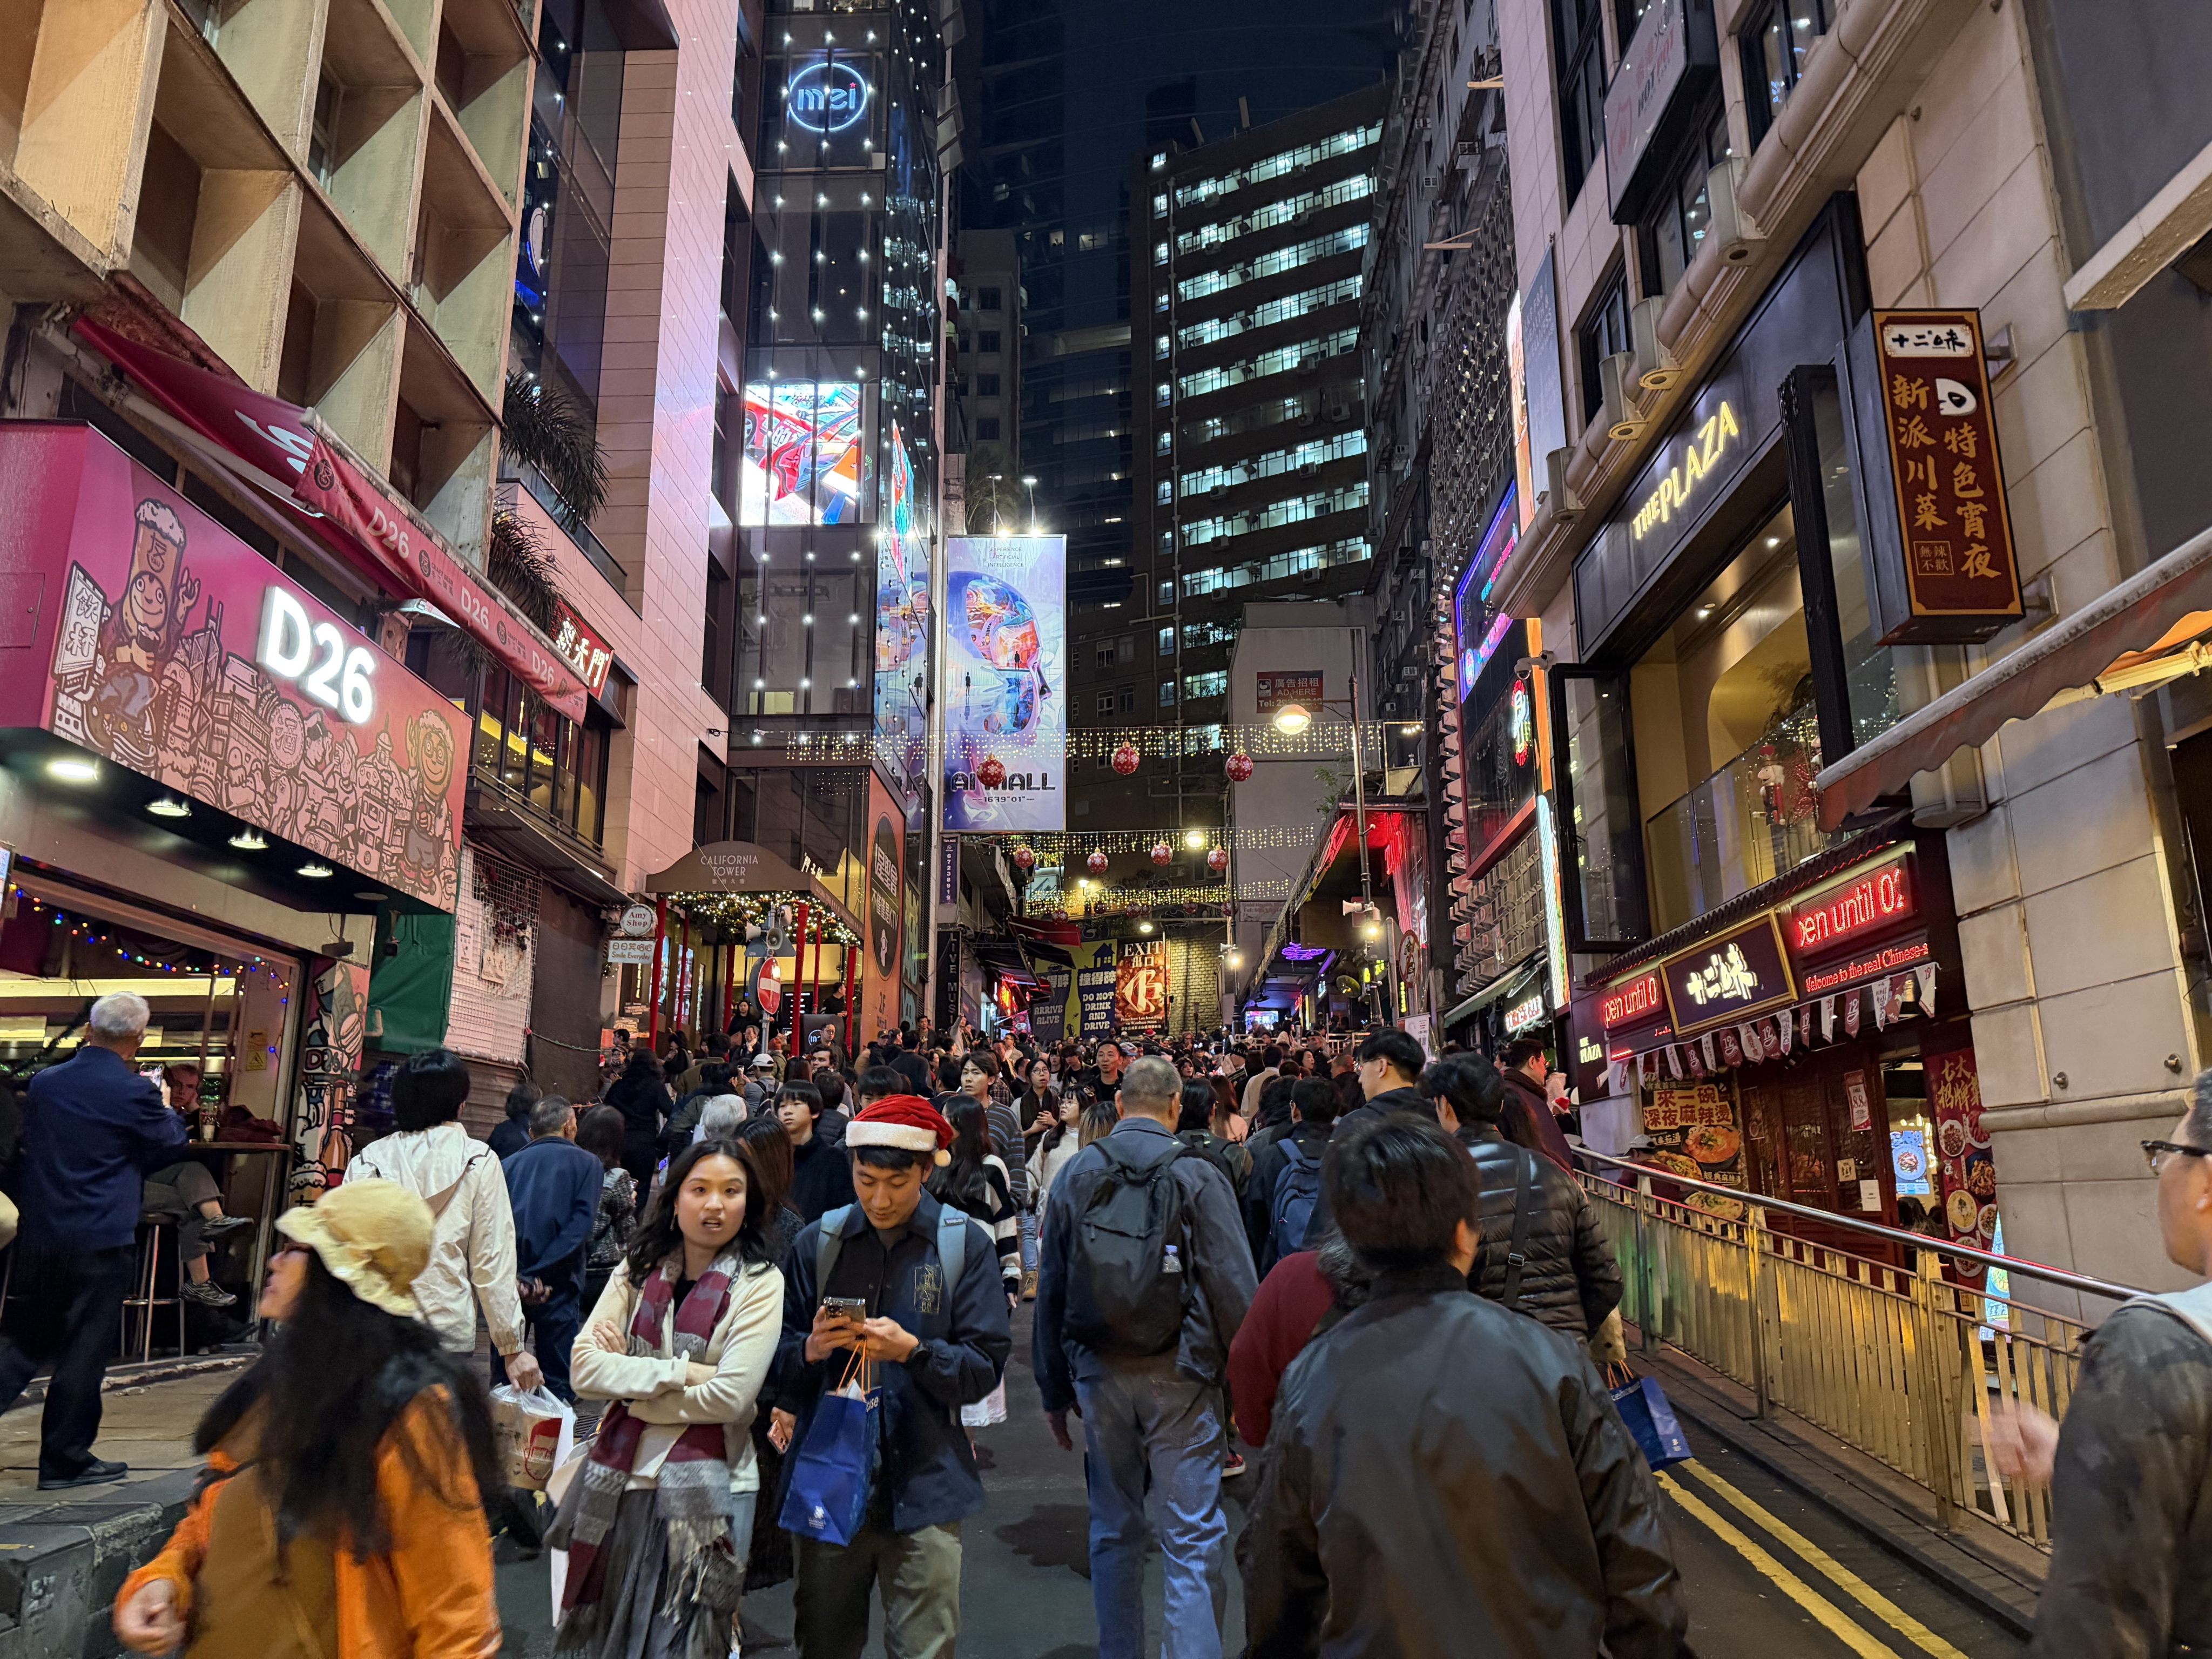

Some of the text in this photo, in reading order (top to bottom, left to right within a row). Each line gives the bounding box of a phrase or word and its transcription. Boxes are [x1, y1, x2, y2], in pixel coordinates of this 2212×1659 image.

[798, 82, 856, 110] mei
[1892, 329, 1966, 352] 十二味
[1892, 373, 1948, 531] 新派川菜
[1633, 401, 1739, 539] THE PLAZA
[1944, 421, 2001, 578] 特色宵夜
[366, 506, 409, 558] D26
[461, 586, 489, 631] D26
[257, 585, 377, 724] D26
[532, 650, 554, 687] D26
[1275, 677, 1319, 688] 廣告招租
[950, 772, 976, 792] AI
[700, 855, 758, 865] CALIFORNIA
[713, 867, 746, 876] TOWER
[1832, 881, 1874, 933] until
[949, 933, 957, 973] LIVE
[1124, 941, 1163, 957] EXIT
[1132, 956, 1154, 968] 出口
[1839, 968, 1847, 982] to
[1849, 962, 1863, 977] the
[1864, 953, 1881, 973] real
[1039, 974, 1069, 988] 得醉
[1687, 943, 1758, 1004] 十二味
[948, 982, 957, 1023] MUSI
[1083, 992, 1114, 1002] DO NOT
[1085, 1002, 1111, 1011] DRINK
[1625, 981, 1647, 1014] until
[1849, 999, 1859, 1016] 12
[1034, 1005, 1063, 1015] ARRIVE
[1036, 1015, 1060, 1024] ALIVE
[1089, 1011, 1106, 1020] AND
[1084, 1021, 1110, 1030] DRIVE
[1762, 1026, 1773, 1040] 12
[1580, 1043, 1602, 1063] PLAZA
[1723, 1035, 1734, 1049] 12
[1941, 1055, 1972, 1081] 七大
[1657, 1086, 1717, 1108] 來一碗
[1644, 1104, 1731, 1127] 深夜麻辣燙
